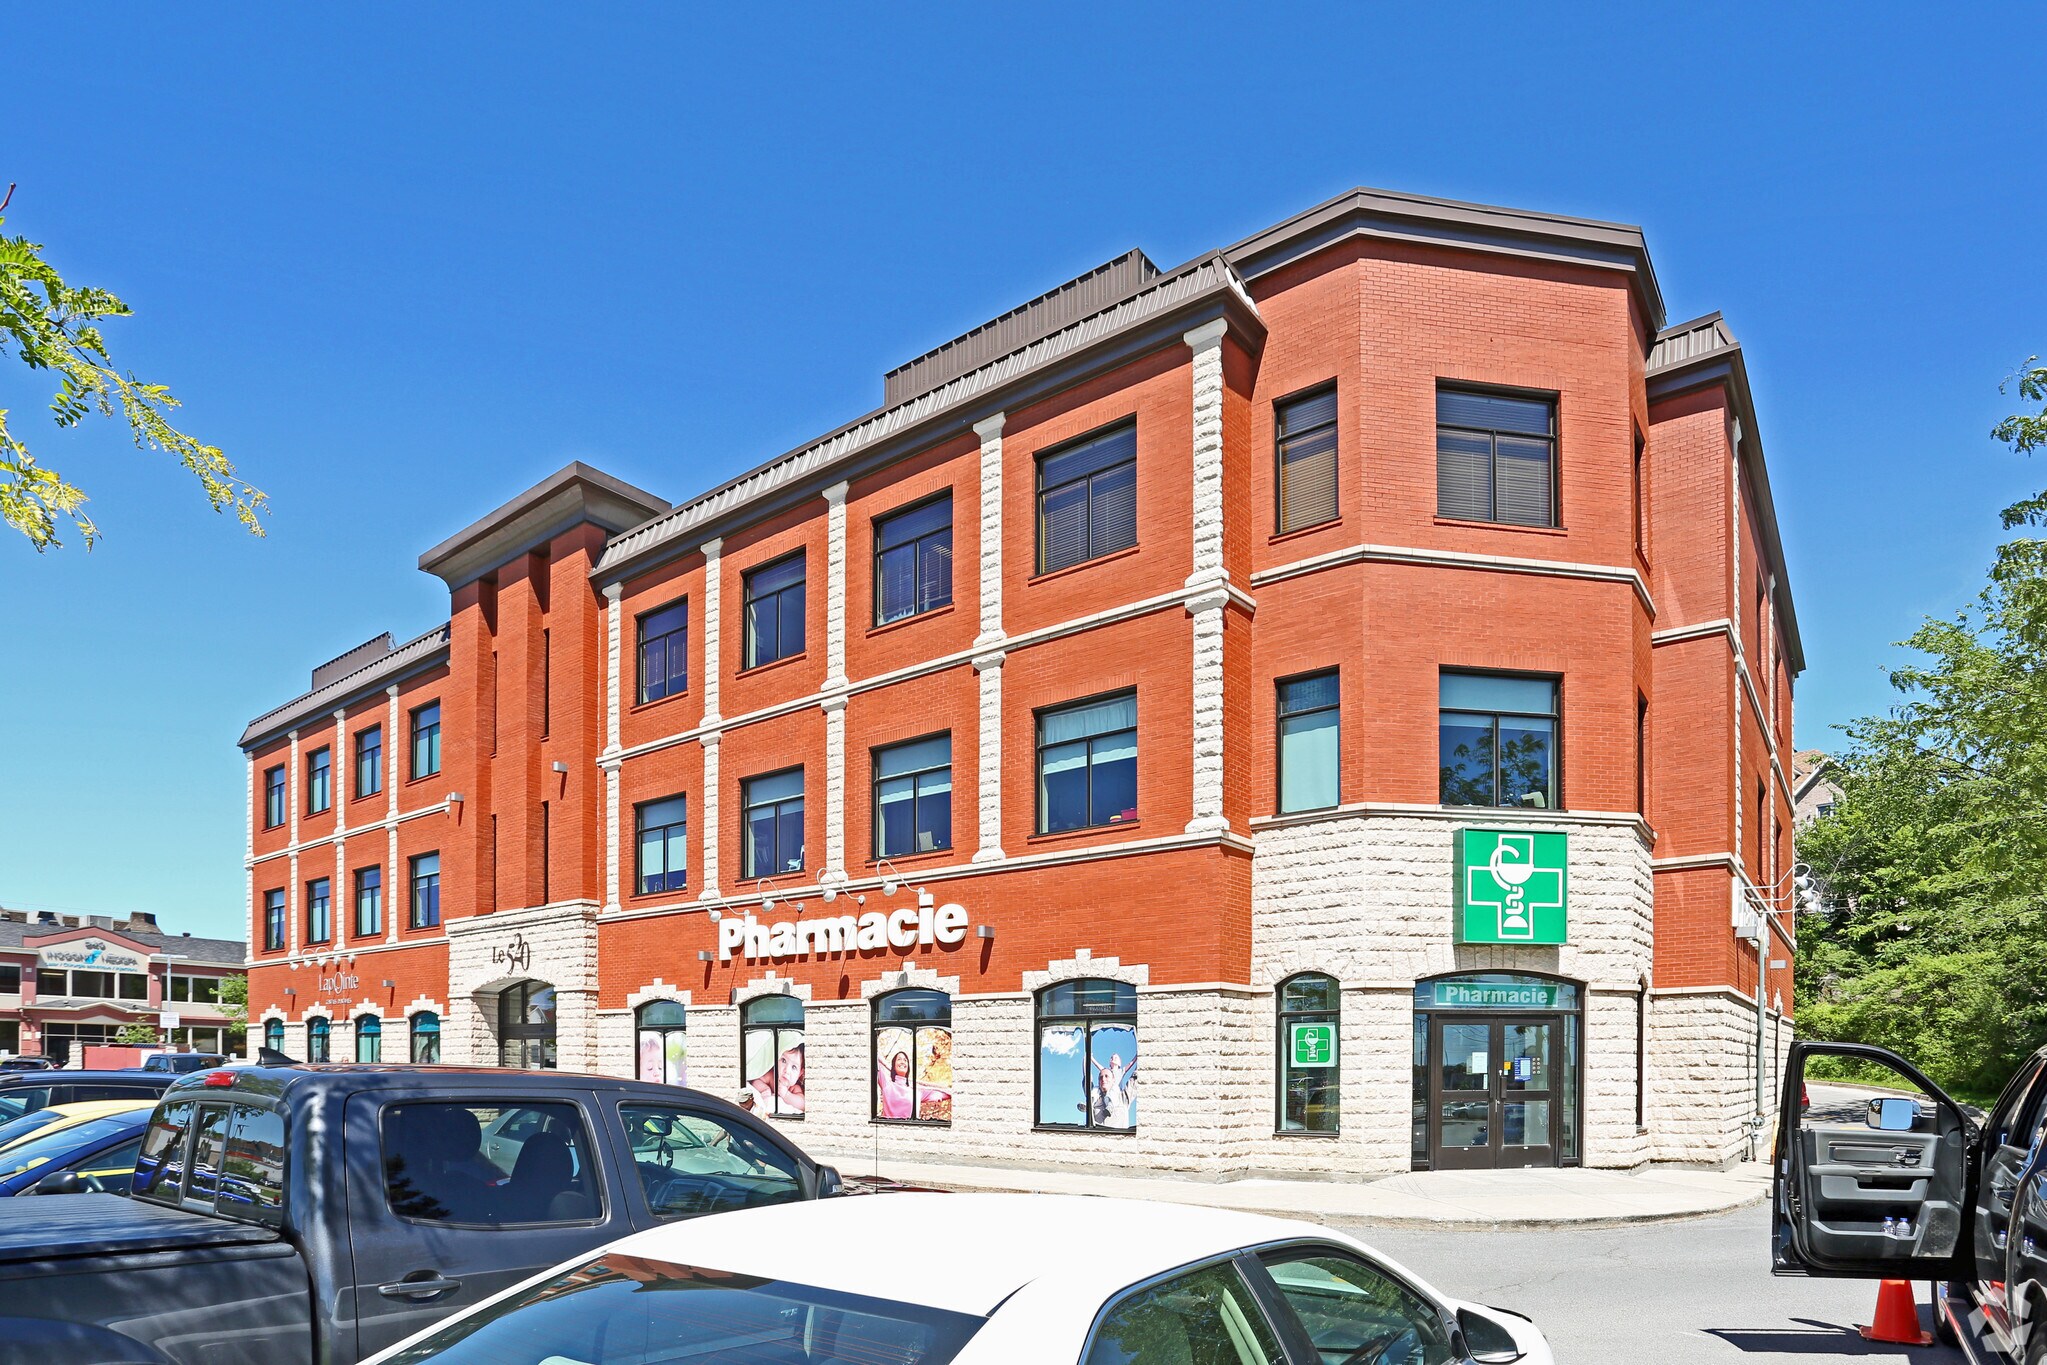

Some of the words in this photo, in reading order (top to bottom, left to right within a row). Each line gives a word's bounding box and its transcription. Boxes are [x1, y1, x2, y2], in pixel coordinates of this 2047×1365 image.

[718, 893, 969, 961] Pharmacie
[492, 946, 505, 964] Le
[1445, 985, 1548, 1004] Pharmacie
